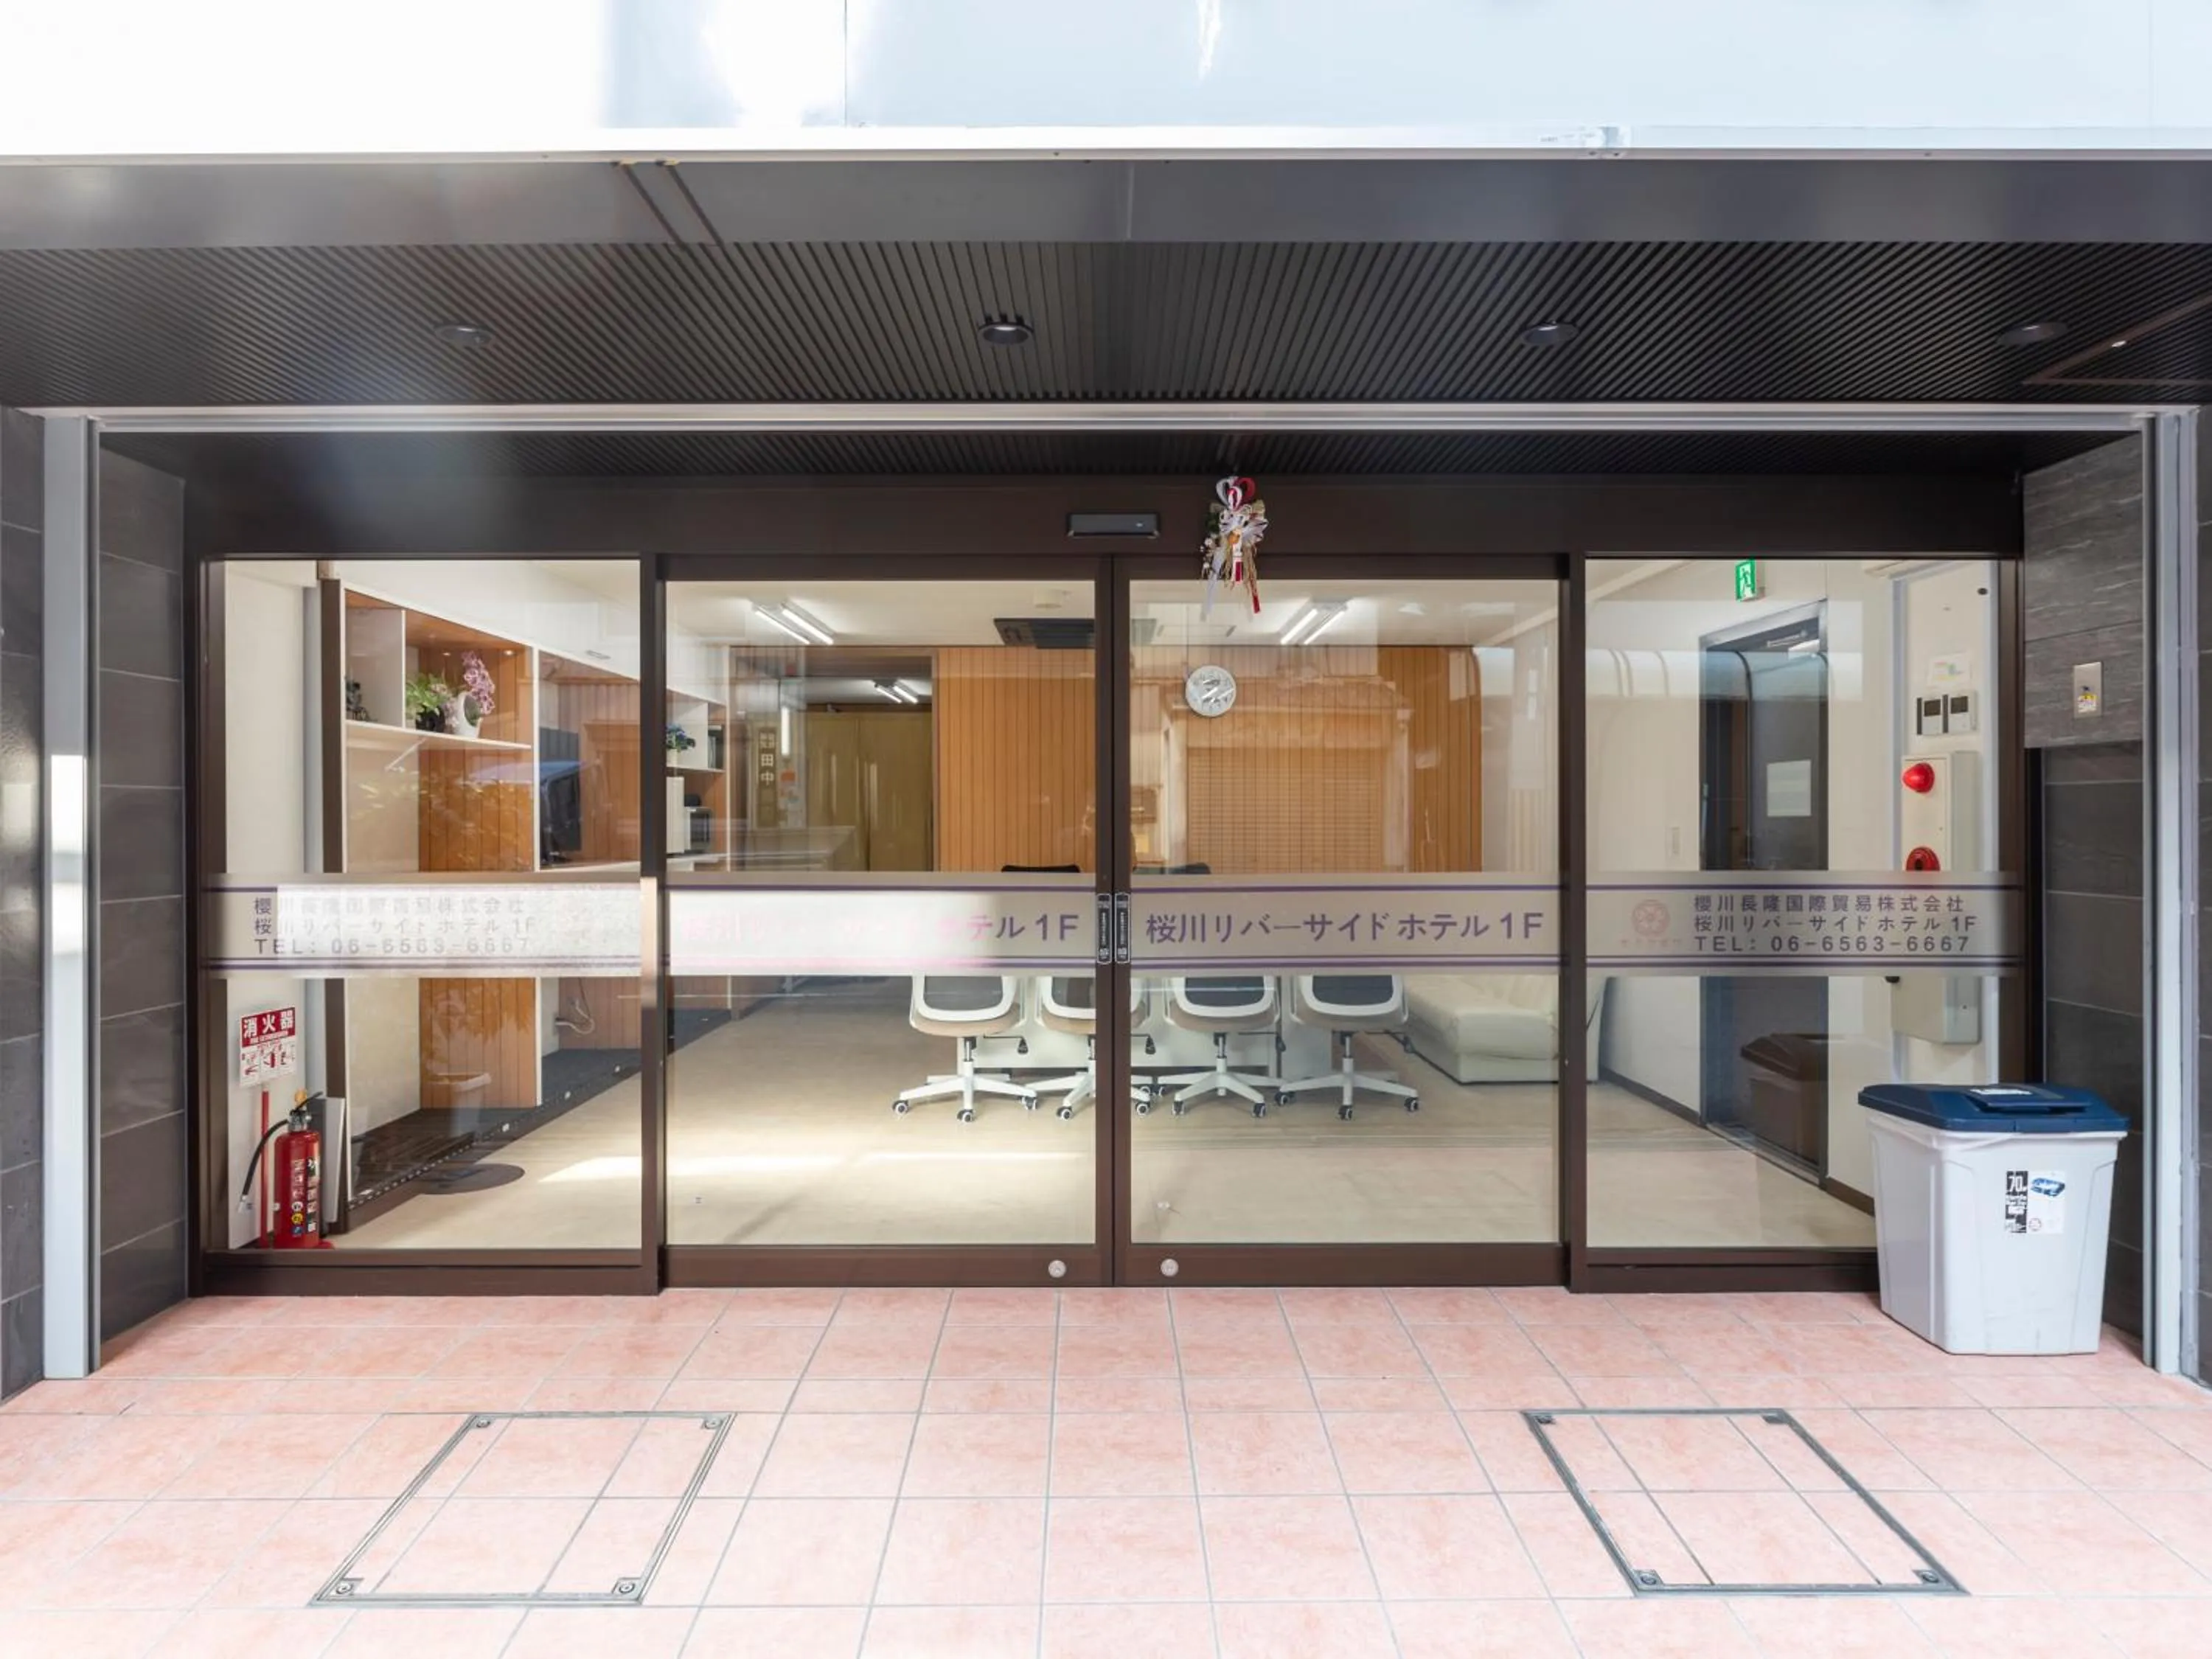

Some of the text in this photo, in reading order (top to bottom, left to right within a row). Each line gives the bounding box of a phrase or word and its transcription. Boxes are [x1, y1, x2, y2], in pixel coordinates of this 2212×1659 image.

[1694, 936, 1756, 952] TEL:
[1771, 936, 1969, 952] 06-6563-6667
[243, 1010, 293, 1038] 消火器
